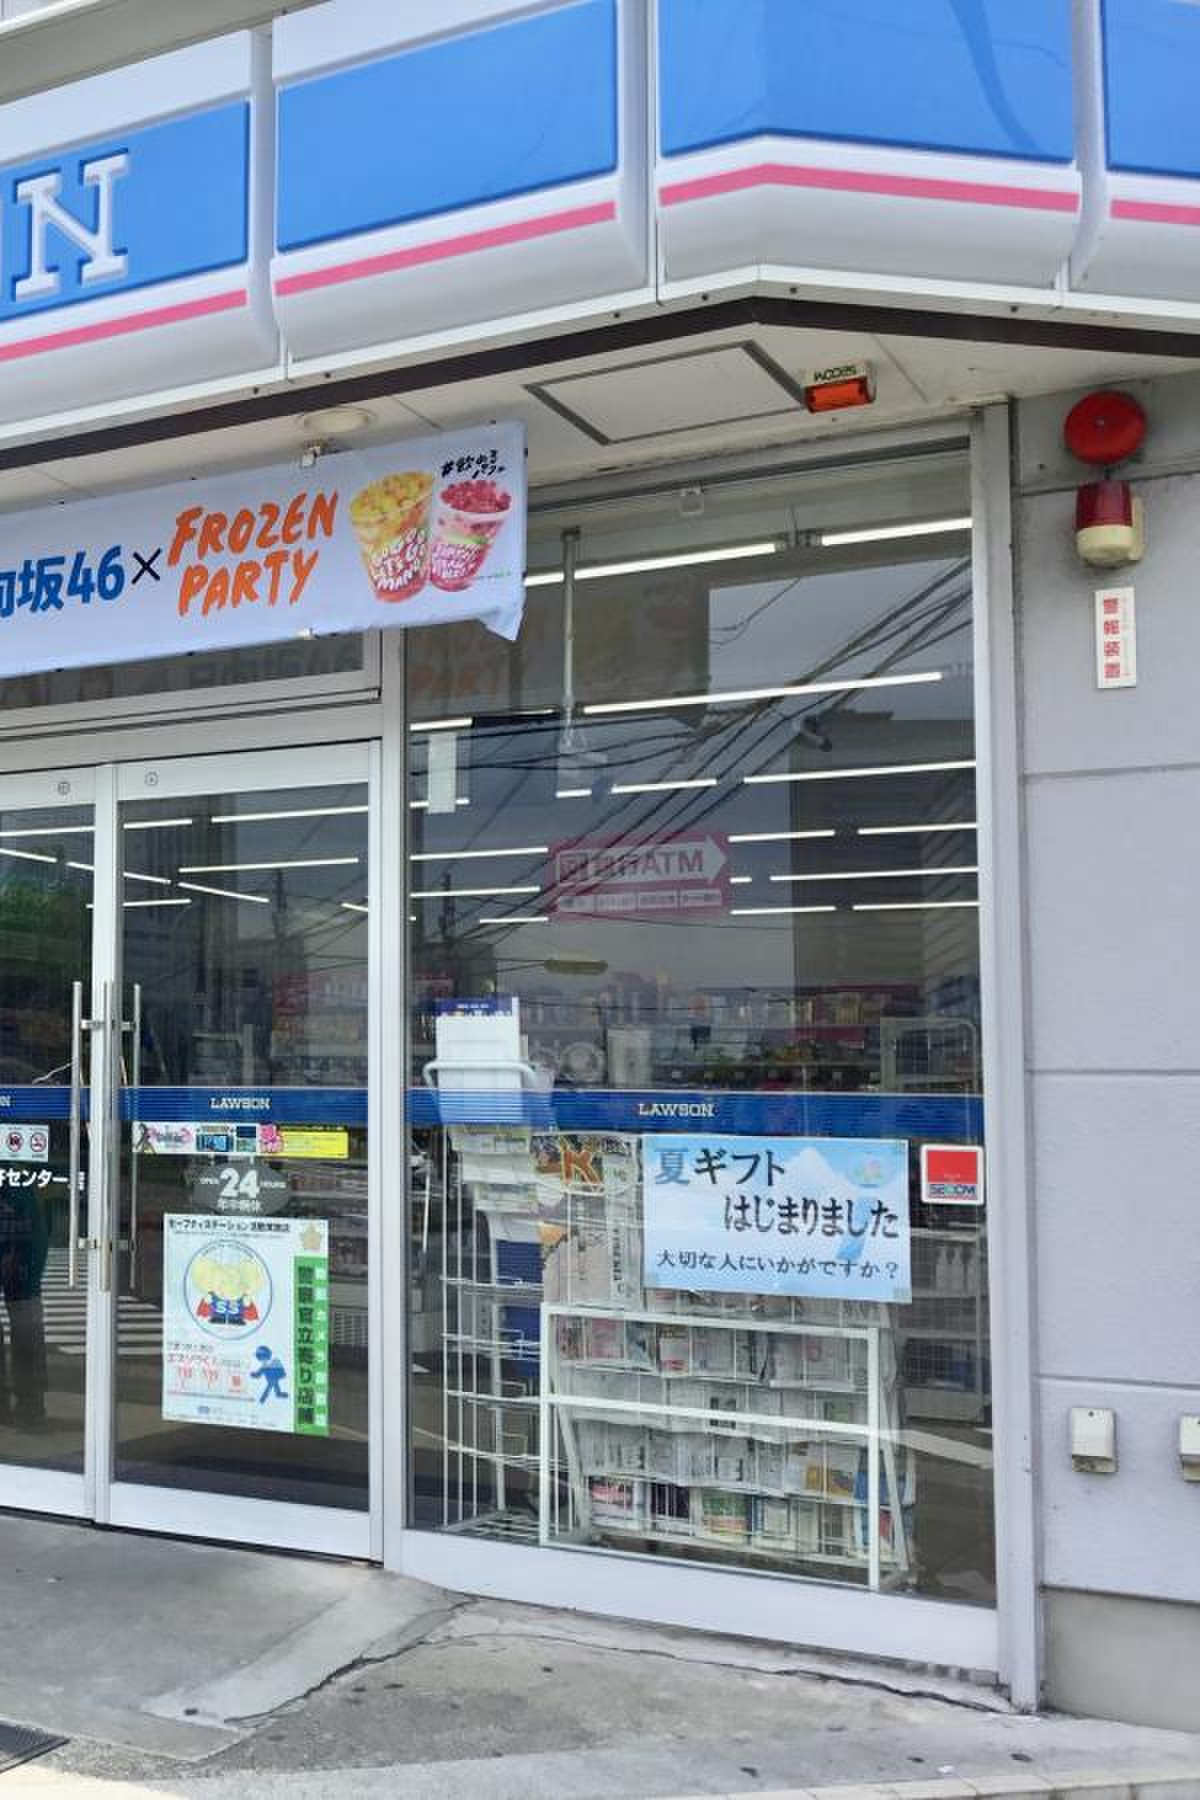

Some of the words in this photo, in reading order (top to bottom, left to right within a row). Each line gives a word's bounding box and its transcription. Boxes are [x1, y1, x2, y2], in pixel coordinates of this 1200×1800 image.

[167, 490, 339, 566] FROZEN
[178, 548, 320, 617] PARTY
[210, 1097, 272, 1111] LAWSON
[638, 1102, 715, 1118] LAWSON
[219, 1166, 261, 1200] 24
[654, 1146, 786, 1187] 夏ギフト
[929, 1184, 977, 1195] SECOM
[724, 1195, 899, 1239] はじまりました
[655, 1250, 899, 1281] 大切な人にいかがですか？
